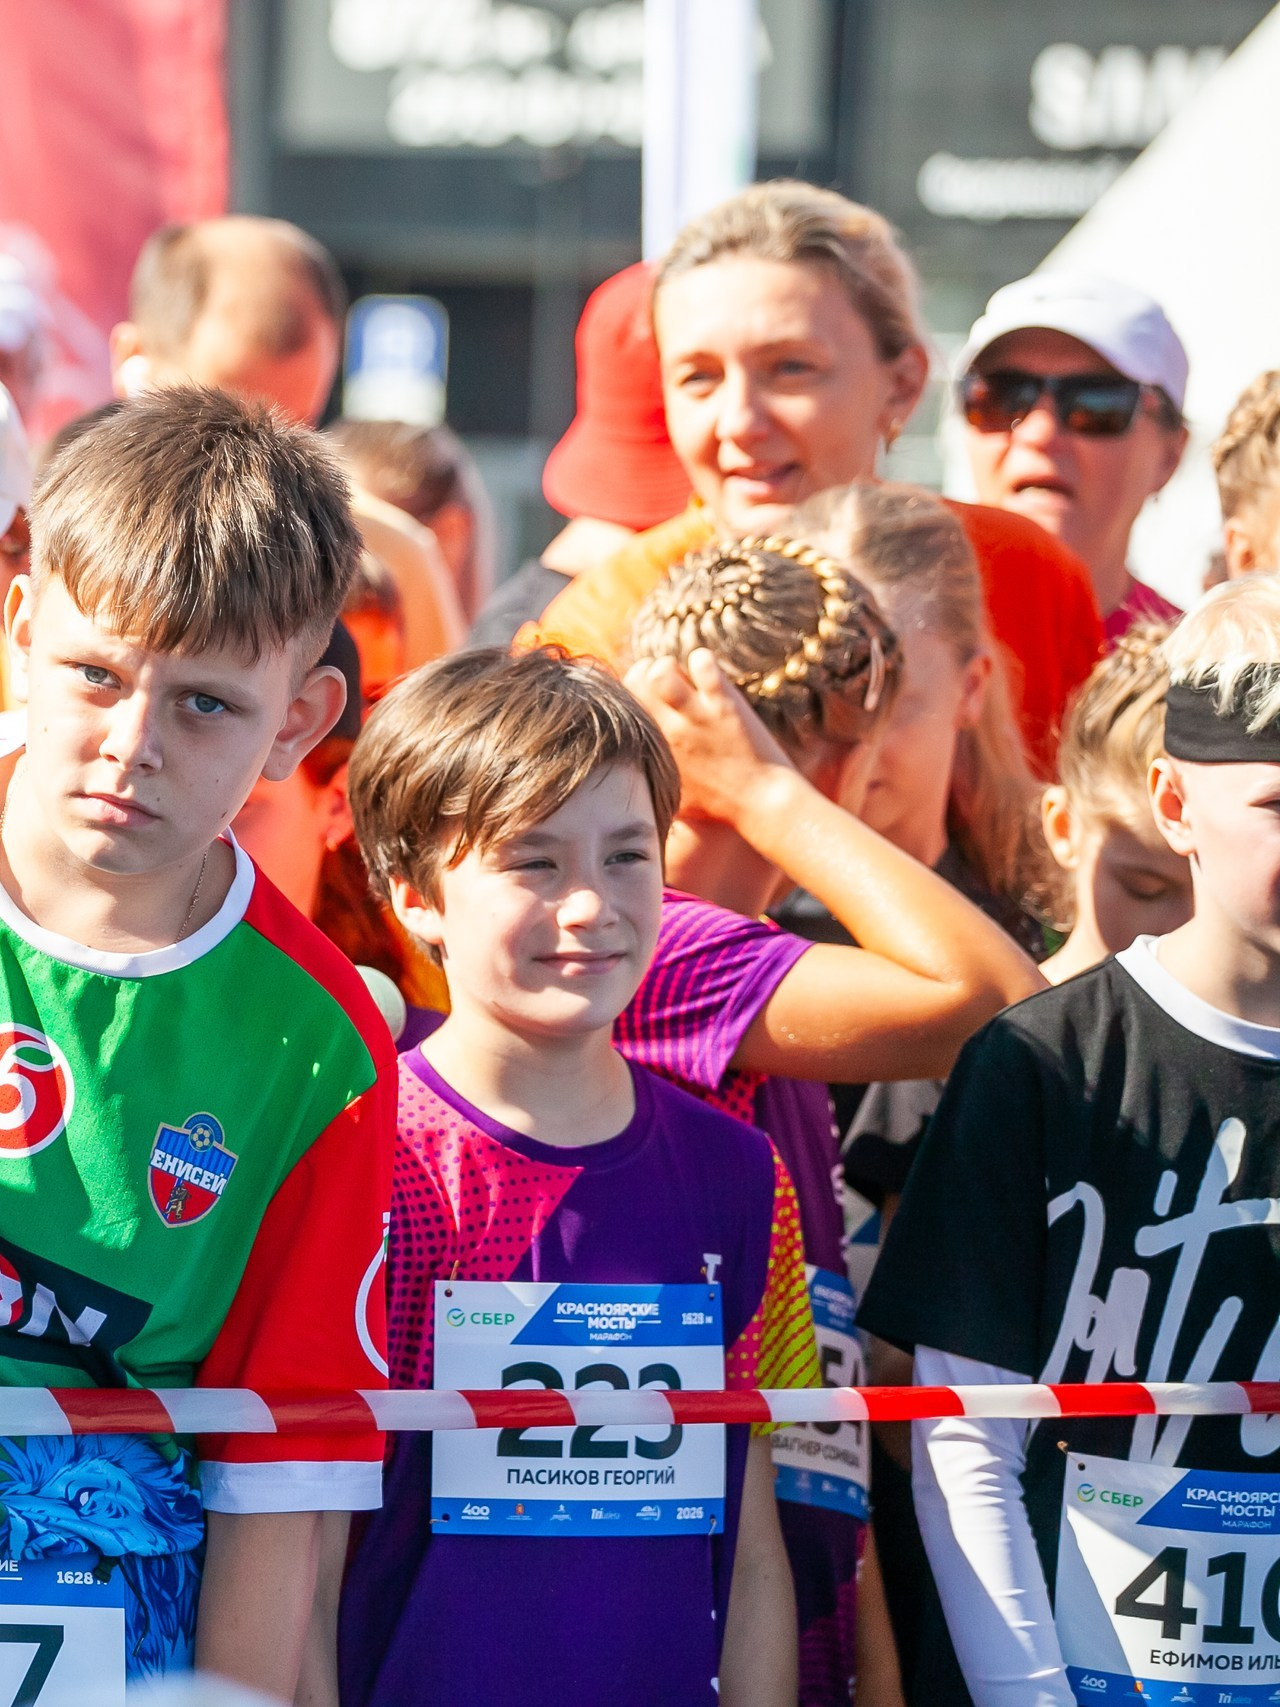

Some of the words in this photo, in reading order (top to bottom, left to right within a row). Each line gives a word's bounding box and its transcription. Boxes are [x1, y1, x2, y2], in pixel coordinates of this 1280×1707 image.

[150, 1148, 228, 1196] ЕНИСЕЙ
[556, 1302, 660, 1317] КРАСНОЯРСКИЕ
[470, 1312, 515, 1326] СБЕР
[587, 1316, 636, 1330] МОСТЫ
[506, 1468, 600, 1486] ПАСИКОВ
[603, 1466, 675, 1486] ГЕОРГИЙ
[1099, 1490, 1144, 1508] СБЕР
[1186, 1487, 1280, 1504] КРАСНОЯРС
[676, 1507, 704, 1520] 2026
[1220, 1503, 1276, 1518] МОСТЫ
[1222, 1519, 1272, 1529] МАРАФОН
[56, 1570, 94, 1585] 1628
[1150, 1649, 1244, 1671] ЕФИМОВ
